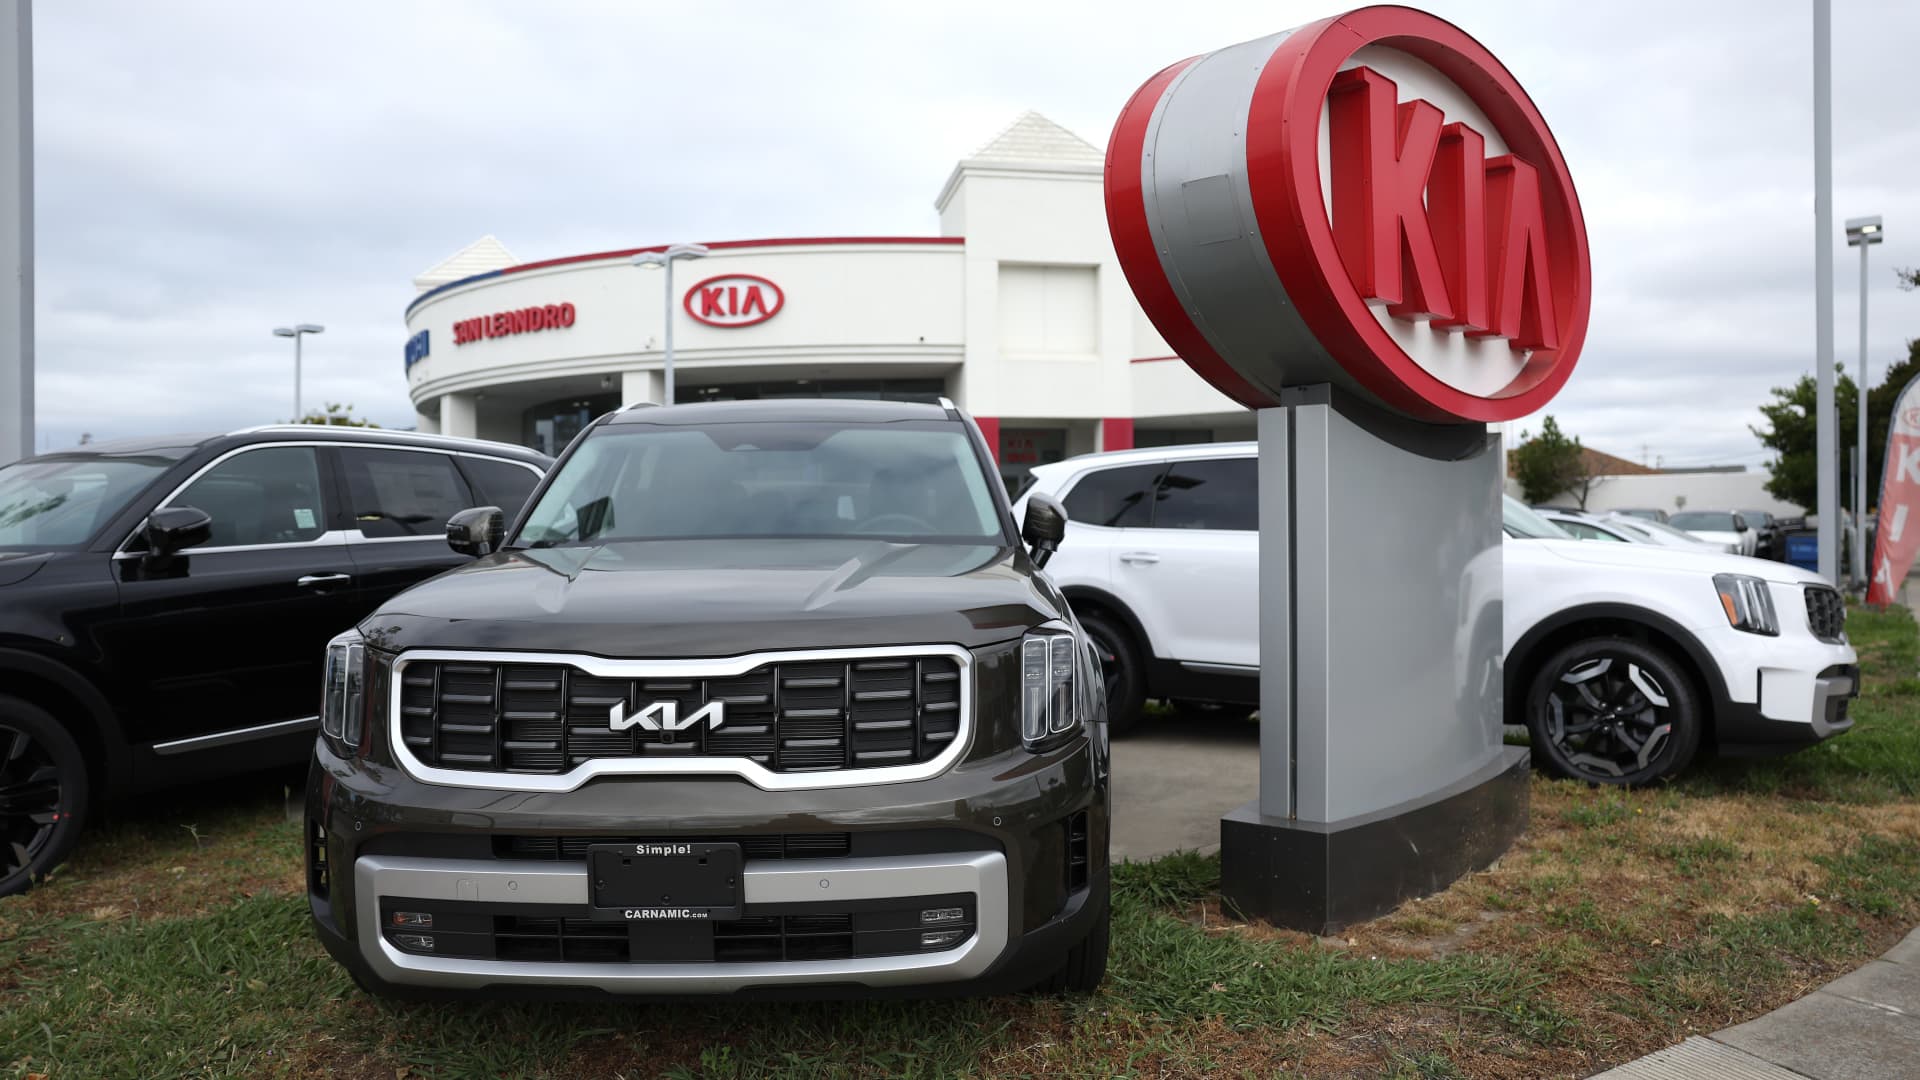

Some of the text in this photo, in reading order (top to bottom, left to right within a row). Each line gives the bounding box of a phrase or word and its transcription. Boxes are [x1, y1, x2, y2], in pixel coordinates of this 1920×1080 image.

[1328, 65, 1560, 351] KIA
[701, 285, 768, 317] KIA
[453, 302, 576, 345] SAN LEANDRO
[609, 700, 724, 730] KIA
[636, 844, 691, 857] Simple!
